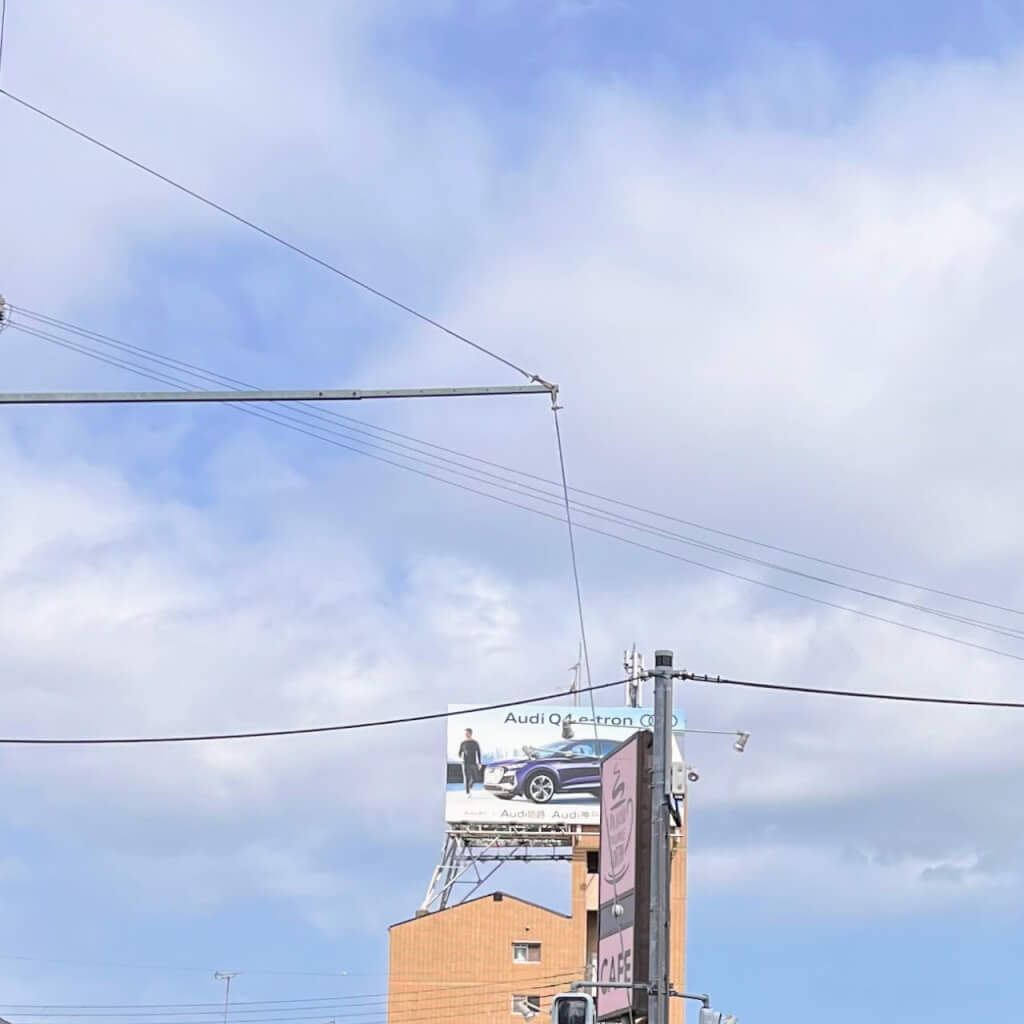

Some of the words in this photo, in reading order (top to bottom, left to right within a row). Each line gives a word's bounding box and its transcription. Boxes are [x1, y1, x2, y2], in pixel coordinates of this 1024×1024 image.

[504, 712, 545, 725] Audi
[578, 714, 633, 726] e-tron
[600, 949, 631, 995] CAFE
